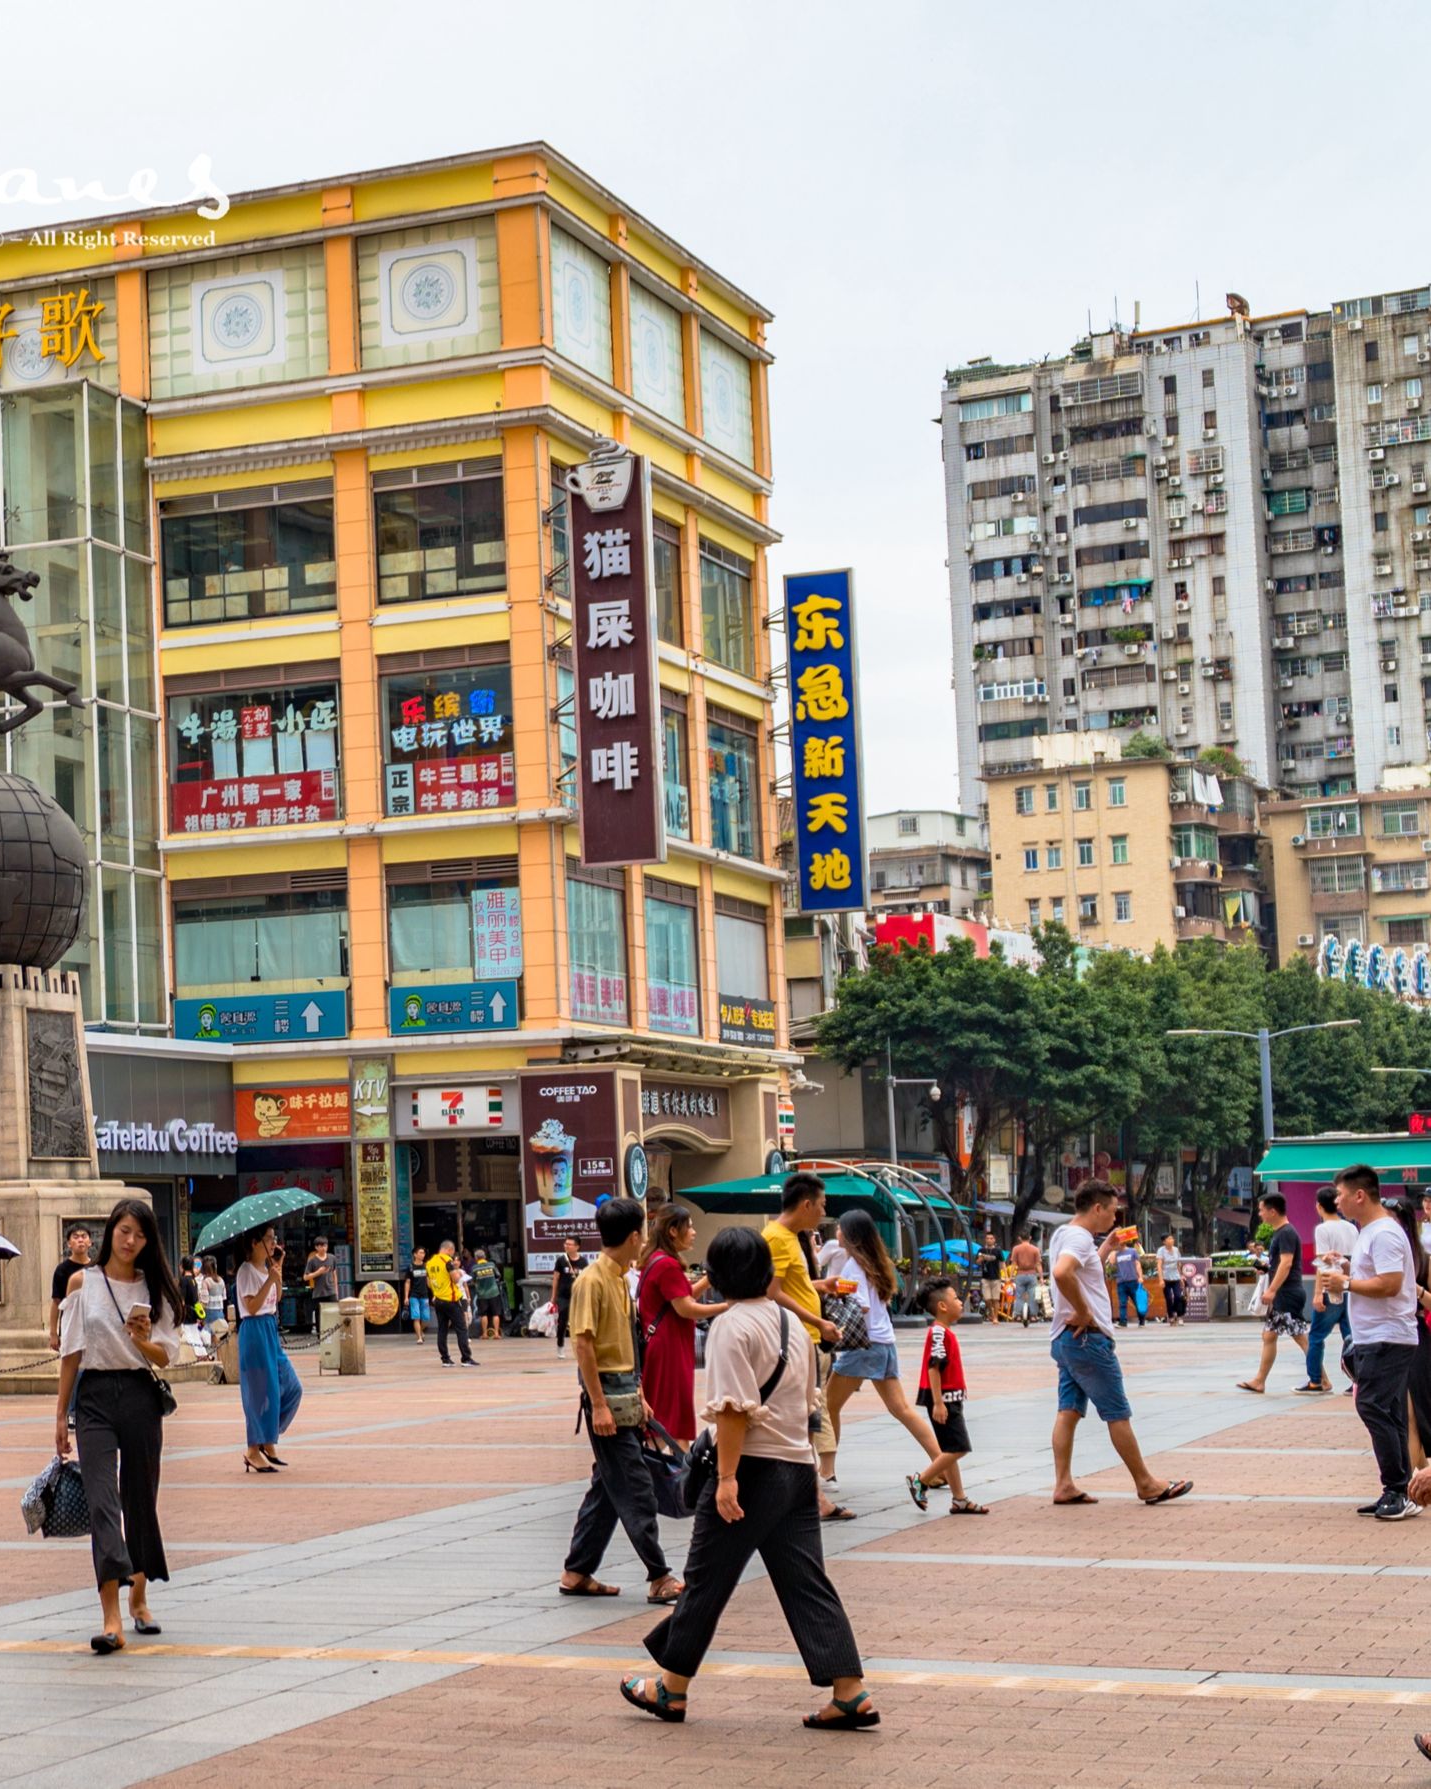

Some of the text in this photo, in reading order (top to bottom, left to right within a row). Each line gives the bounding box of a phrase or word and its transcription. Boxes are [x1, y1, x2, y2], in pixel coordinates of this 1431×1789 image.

[583, 528, 639, 791] 猫屎咖啡
[392, 714, 505, 752] 电玩世界
[791, 593, 853, 892] 东急新天地
[419, 762, 499, 787] 牛三星汤
[201, 779, 302, 809] 广州第一家
[354, 1079, 386, 1100] KTV
[539, 1086, 575, 1097] COFFEE
[170, 1118, 239, 1154] Coffee
